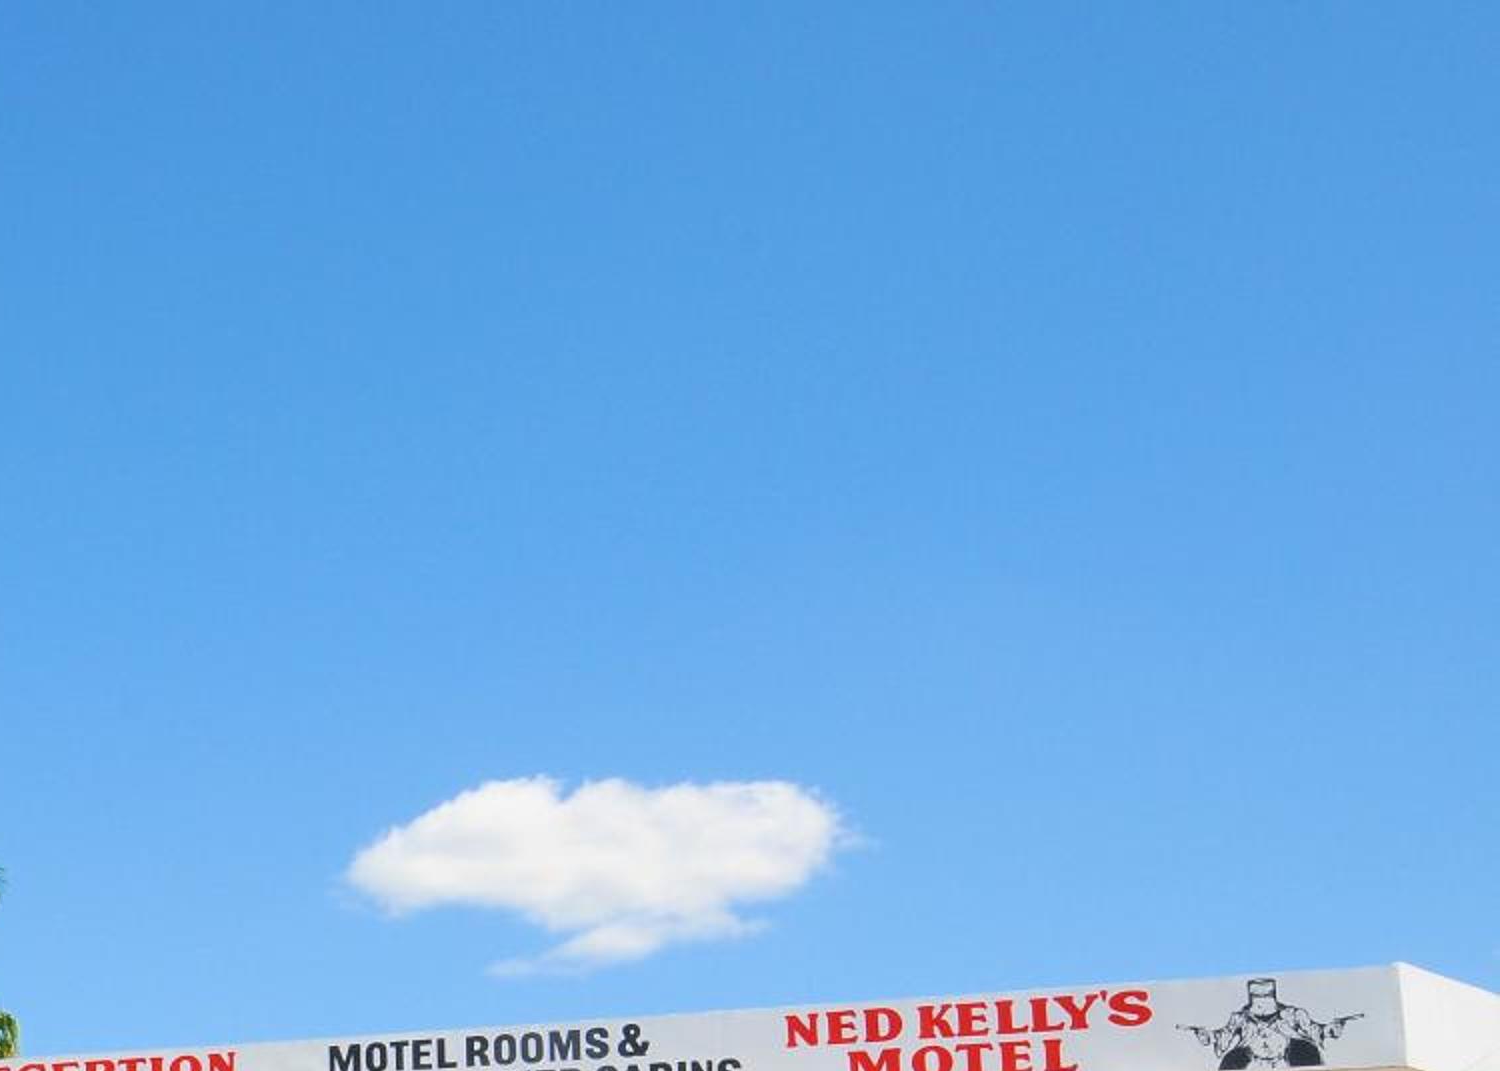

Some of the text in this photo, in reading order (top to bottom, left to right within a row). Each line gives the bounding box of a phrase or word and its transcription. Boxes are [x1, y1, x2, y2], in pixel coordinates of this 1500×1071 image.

[465, 1027, 610, 1067] ROOMS
[617, 1023, 650, 1058] &
[784, 990, 1153, 1049] NED KELLY'S
